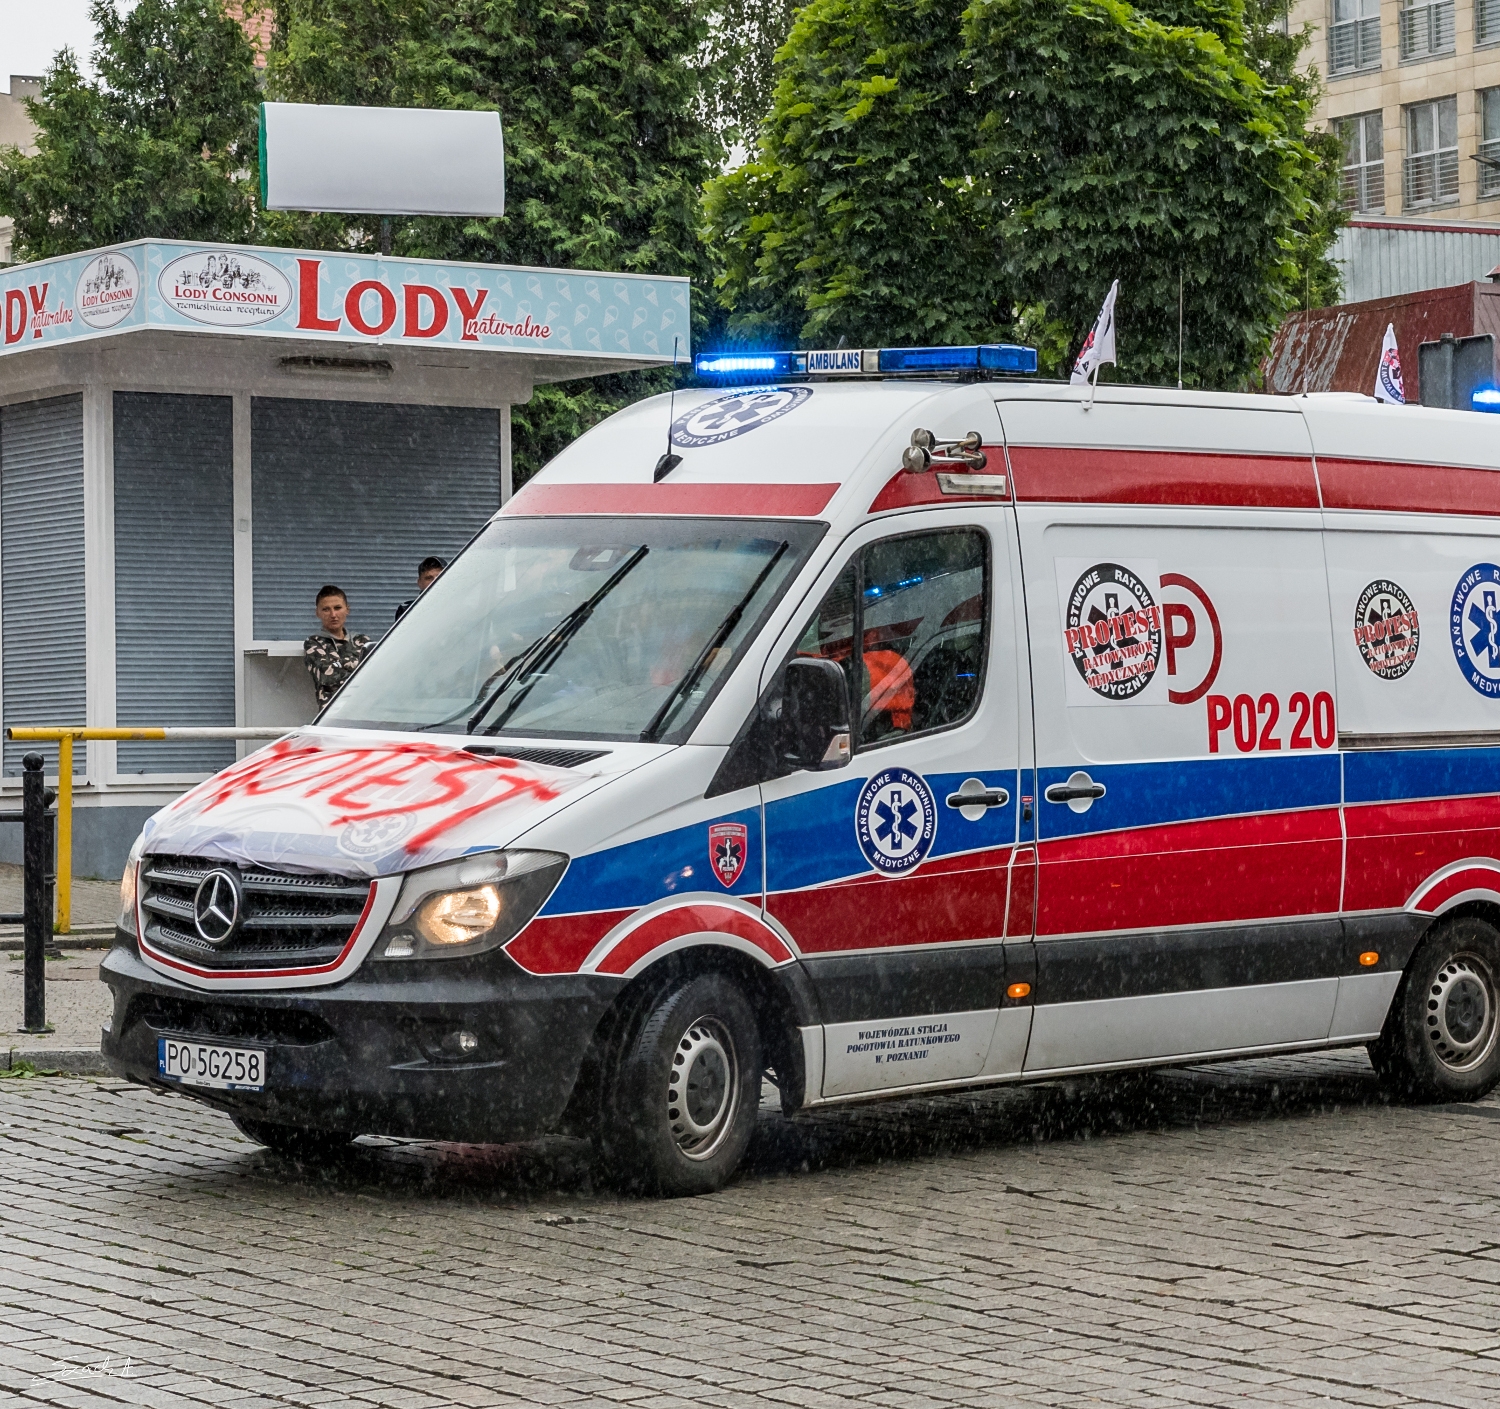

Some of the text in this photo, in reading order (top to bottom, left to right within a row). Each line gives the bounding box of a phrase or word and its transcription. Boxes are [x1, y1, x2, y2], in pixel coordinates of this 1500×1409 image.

[82, 287, 133, 307] LODY CONSONNI
[175, 285, 278, 304] LODY CONSONNI
[296, 258, 488, 341] LODY
[0, 283, 48, 344] DY
[31, 301, 73, 329] naturalne
[176, 302, 275, 316] rzemieślnicza receptura
[465, 313, 552, 338] naturalne
[809, 352, 859, 369] AMBULANS
[673, 429, 739, 445] MEDYCZNE
[1452, 569, 1482, 657] PAŃSTWOWE
[1064, 605, 1161, 654] PROTEST
[1353, 611, 1419, 646] PROTEST
[1086, 659, 1155, 689] MEDYCZNYCH
[1289, 691, 1335, 749] 20
[859, 773, 890, 842] PAŃSTWOWE
[901, 773, 932, 839] RATOWNICTWO
[873, 849, 920, 867] MEDYCZNE
[846, 1034, 960, 1054] POGOTOWIA RATUNKOWEGO
[858, 1023, 947, 1040] WOJEWÓDZKA STACJA
[160, 1060, 165, 1068] PL
[168, 1043, 260, 1082] PO 5G258
[886, 1050, 929, 1062] POZNANIU
